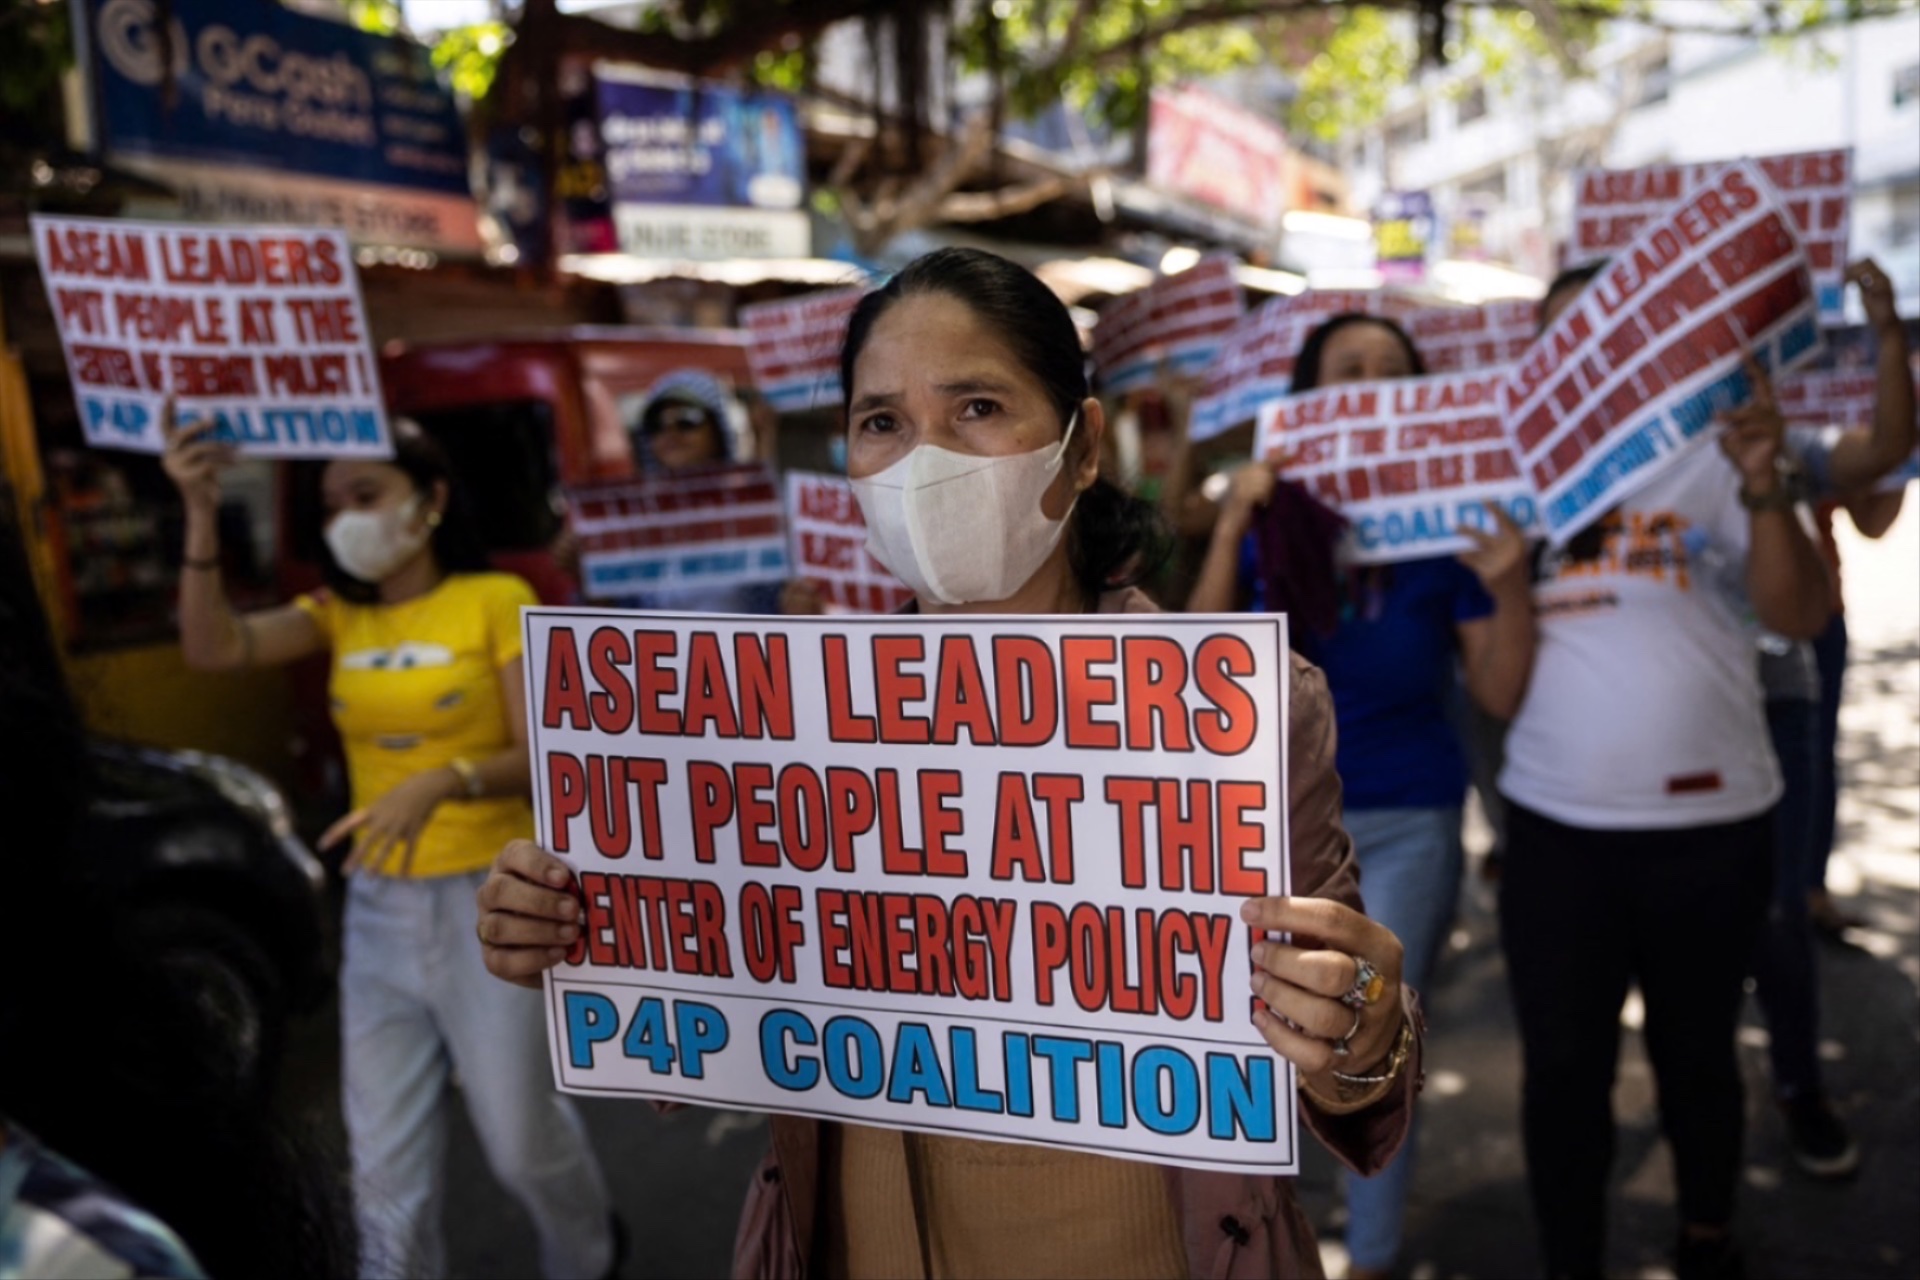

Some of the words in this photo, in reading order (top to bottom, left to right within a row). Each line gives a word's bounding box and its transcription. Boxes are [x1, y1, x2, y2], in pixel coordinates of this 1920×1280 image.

[46, 228, 149, 282] ASEAN
[158, 234, 344, 287] LEADERS
[55, 286, 107, 338] PUT
[113, 291, 230, 345] PEOPLE
[239, 296, 278, 345] AT
[286, 296, 360, 344] THE
[1506, 307, 1594, 415] ASEAN
[1593, 171, 1760, 318] LEADERS
[176, 405, 379, 445] ALITION
[1266, 391, 1378, 434] ASEAN
[543, 626, 796, 741] ASEAN
[821, 632, 1258, 757] LEADERS
[547, 751, 668, 860] PUT
[686, 759, 969, 878] PEOPLE
[990, 770, 1085, 885] AT
[1104, 775, 1268, 896] THE
[738, 880, 805, 984] OF
[815, 887, 1018, 1003] ENERGY
[1030, 900, 1232, 1023] POLICY
[563, 989, 730, 1081] P4P
[758, 1007, 1277, 1144] COALITION
